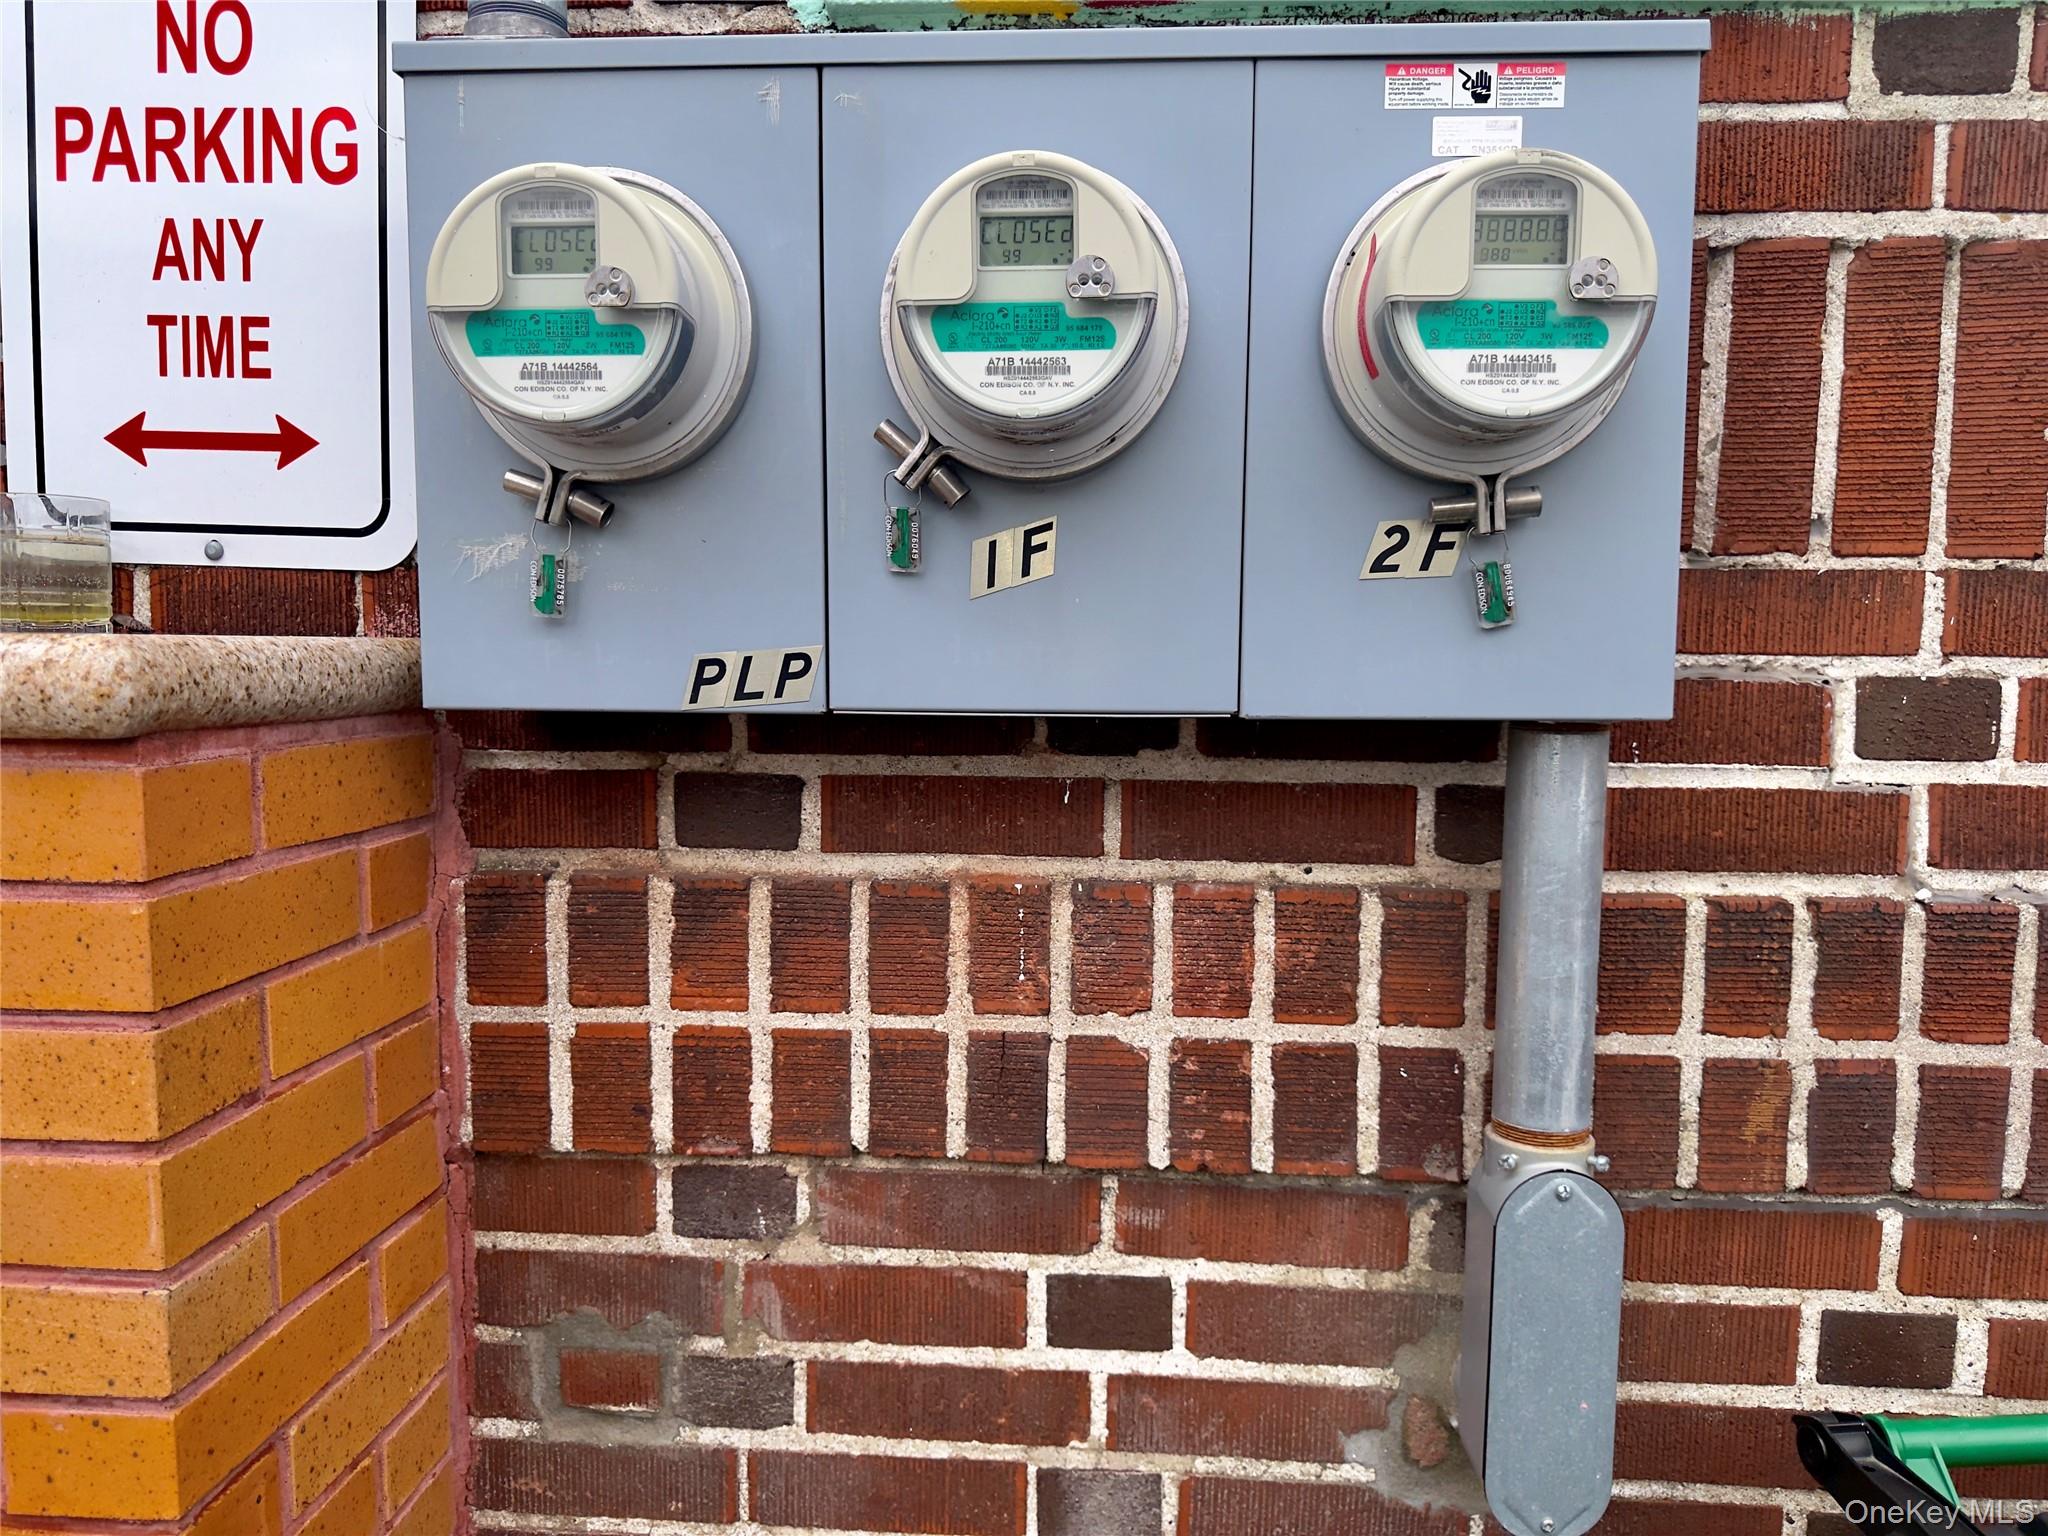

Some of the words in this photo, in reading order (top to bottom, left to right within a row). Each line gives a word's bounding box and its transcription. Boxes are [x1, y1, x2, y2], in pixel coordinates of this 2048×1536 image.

[157, 0, 253, 75] NO
[1410, 67, 1446, 75] DANGER
[1516, 66, 1555, 74] PELIGRO
[55, 106, 358, 185] PARKING
[152, 218, 264, 282] ANY
[951, 309, 995, 321] Aclara
[147, 314, 272, 379] TIME
[988, 357, 1015, 366] A71B
[1020, 357, 1067, 366] 14442563
[1470, 354, 1498, 363] A71B
[1502, 354, 1552, 363] 14443415
[521, 362, 548, 371] A71B
[551, 362, 598, 371] 14442564
[911, 522, 920, 559] 0076049
[1368, 523, 1470, 573] 2F
[556, 568, 566, 607] 0075785
[689, 652, 812, 704] PLP
